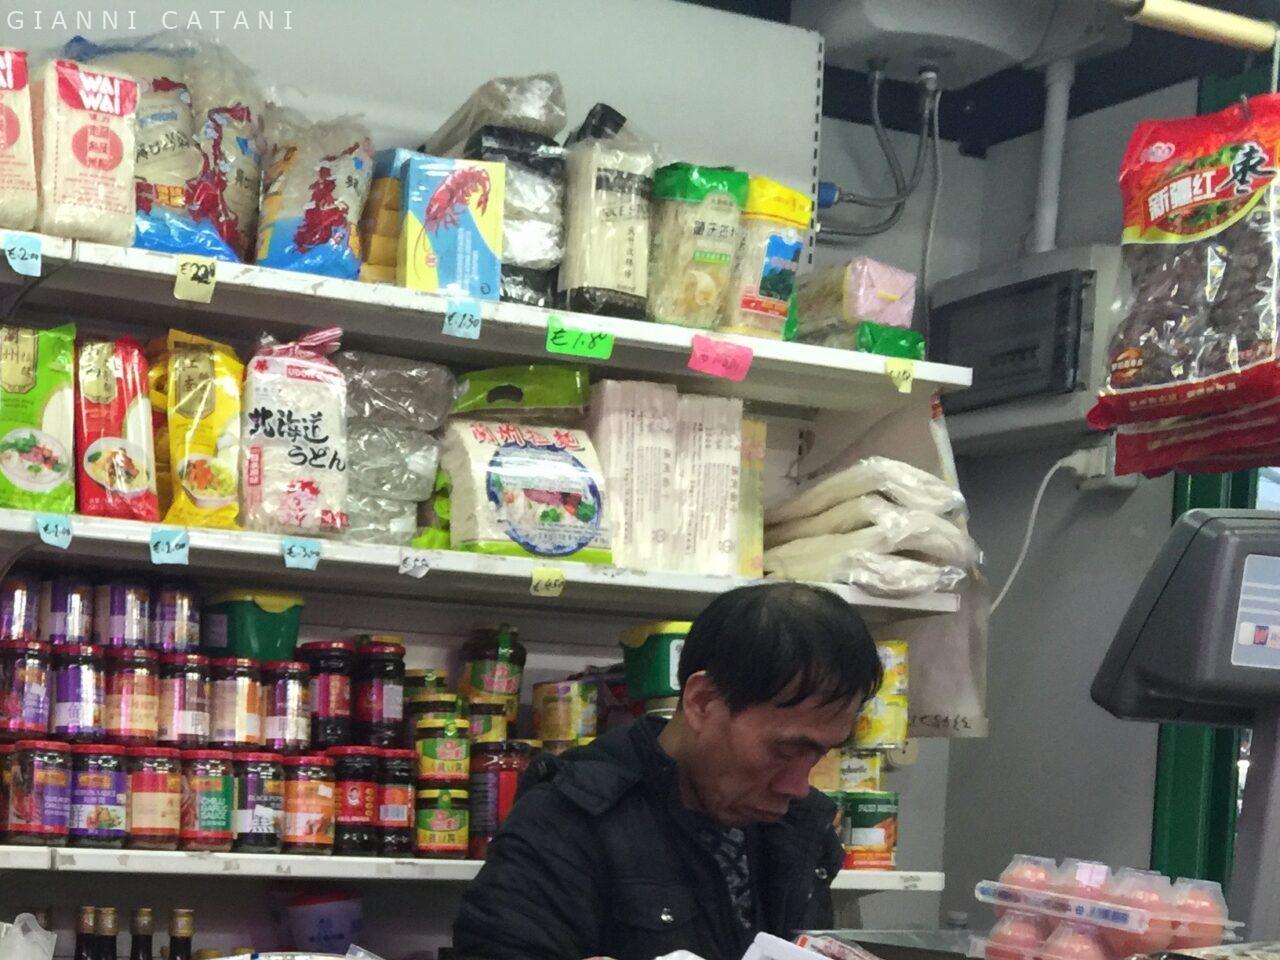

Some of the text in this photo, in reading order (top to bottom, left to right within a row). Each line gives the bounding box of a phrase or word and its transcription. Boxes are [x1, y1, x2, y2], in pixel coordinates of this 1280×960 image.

[79, 71, 120, 93] WAI
[79, 91, 120, 114] WAI
[248, 406, 330, 444] 北海道
[288, 445, 347, 472] うどん
